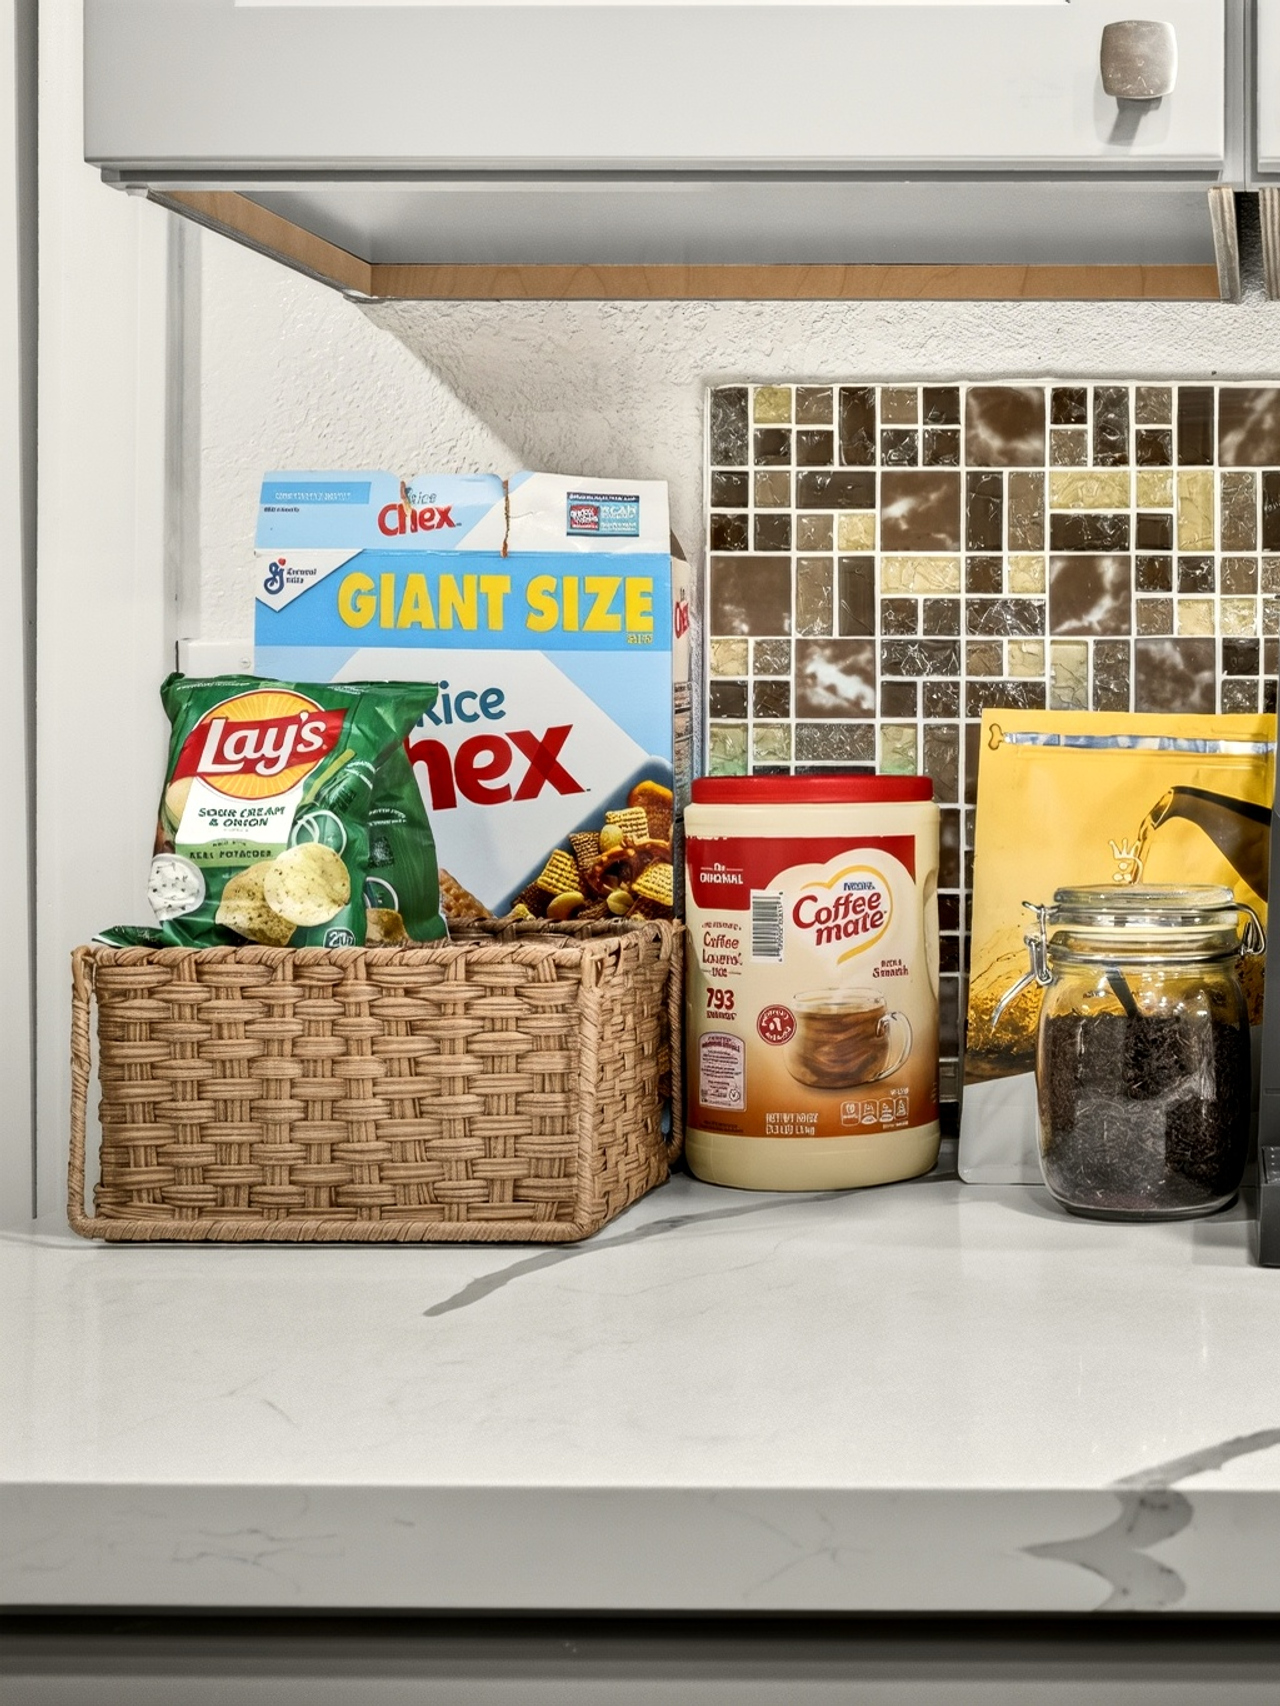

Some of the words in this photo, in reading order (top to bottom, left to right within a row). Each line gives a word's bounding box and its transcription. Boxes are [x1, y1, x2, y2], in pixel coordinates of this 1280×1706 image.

[338, 573, 511, 630] GIANT
[526, 575, 654, 632] SIZE
[197, 711, 327, 776] Lay's
[198, 807, 237, 817] SOUR
[223, 818, 269, 827] ONION
[792, 892, 882, 929] Coffee
[815, 910, 884, 946] mate
[706, 987, 735, 1010] 793
